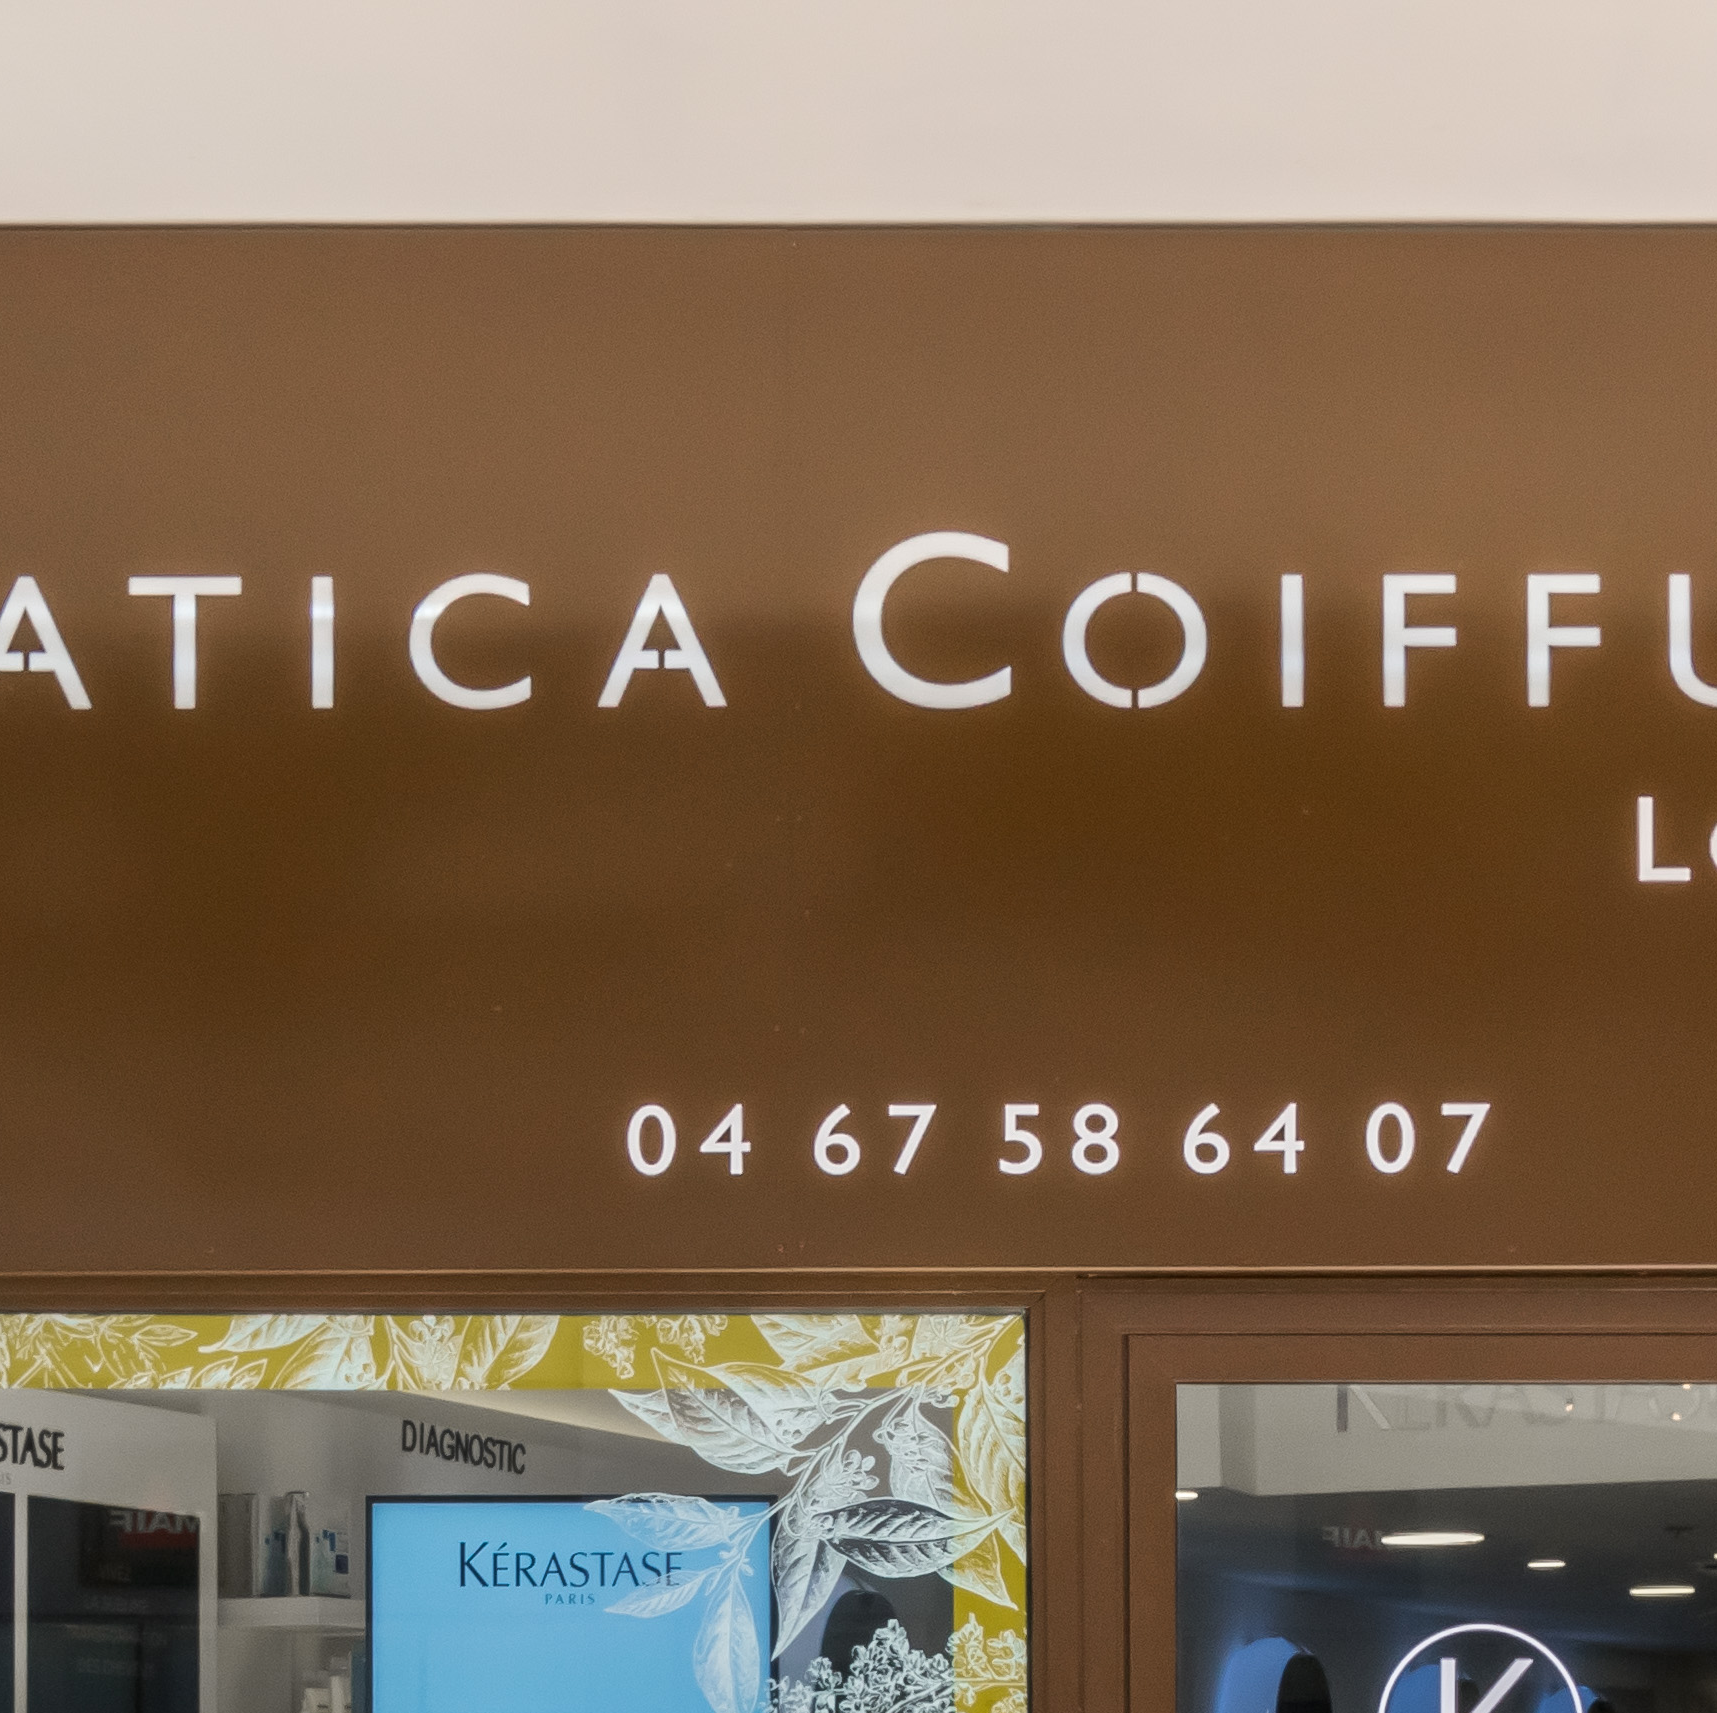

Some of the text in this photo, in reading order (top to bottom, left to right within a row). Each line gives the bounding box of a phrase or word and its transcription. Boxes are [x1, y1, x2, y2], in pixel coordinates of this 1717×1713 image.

[626, 1103, 1492, 1177] 04 67 58 64 07
[401, 1420, 526, 1474] DIAGNOSTIC
[458, 1541, 683, 1588] KÉRASTASE
[544, 1593, 596, 1605] PARIS
